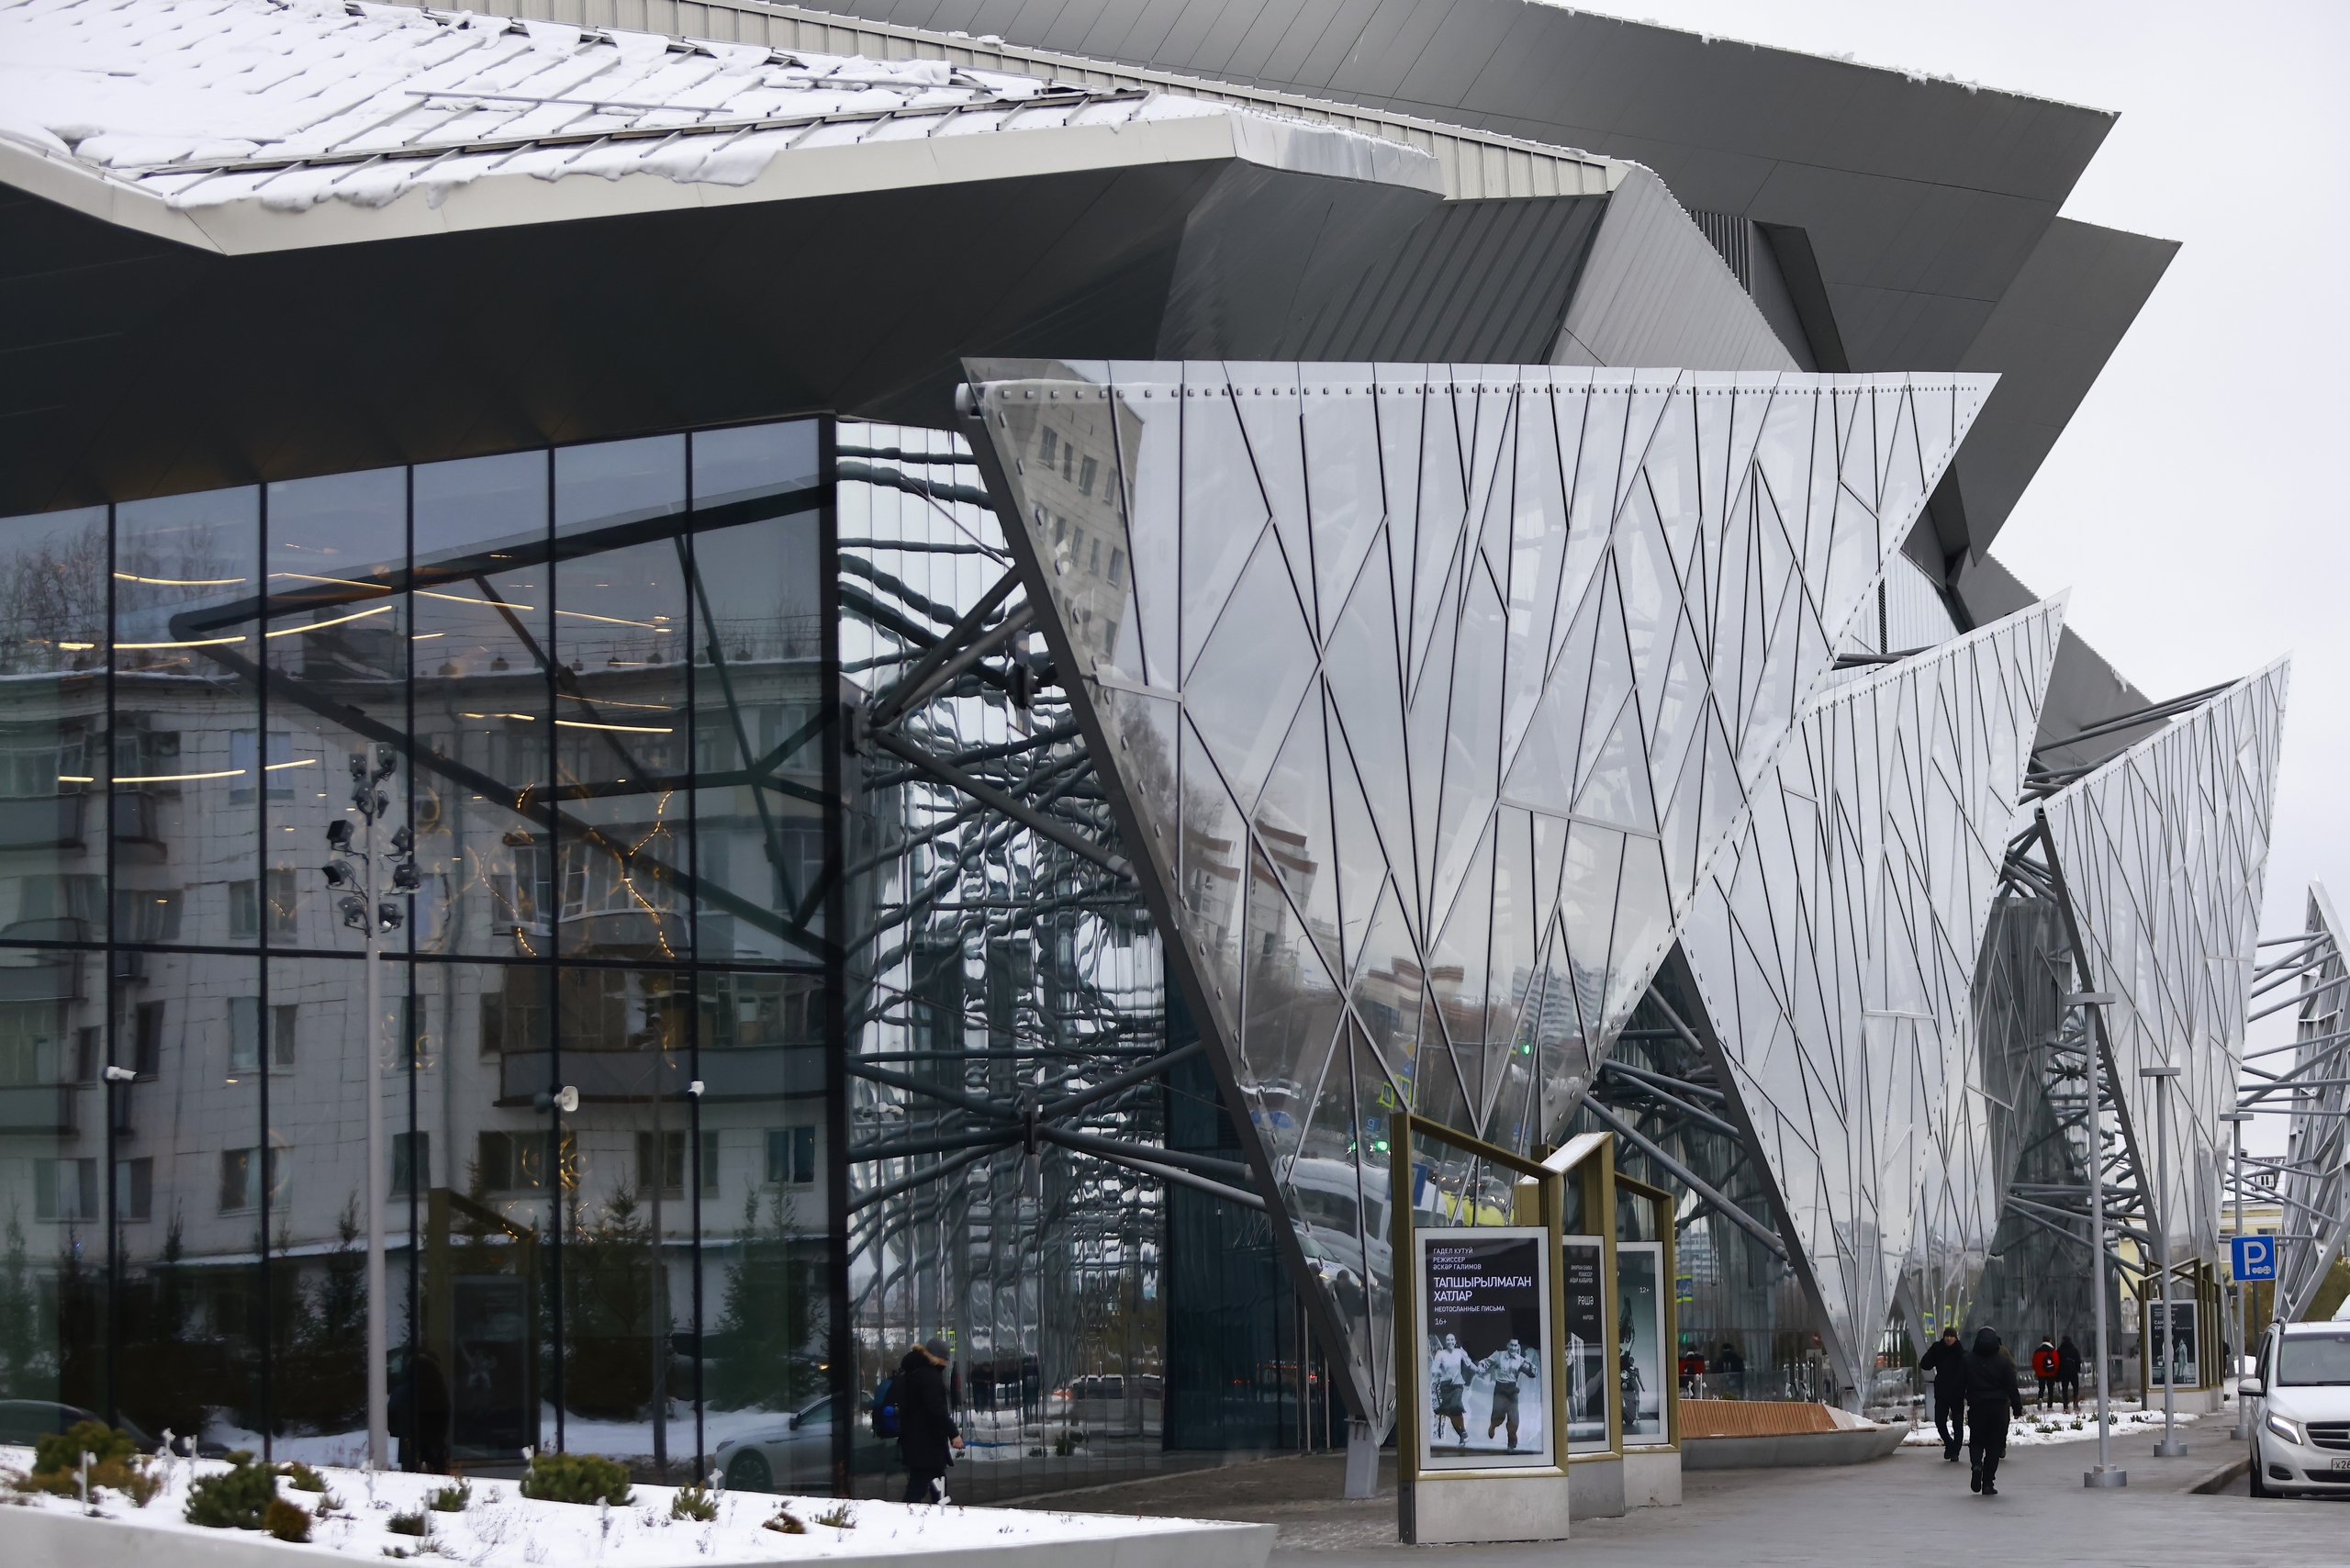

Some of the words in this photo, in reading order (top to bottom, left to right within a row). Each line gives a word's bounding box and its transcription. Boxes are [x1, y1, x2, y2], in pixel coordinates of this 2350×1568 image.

[2243, 1241, 2266, 1276] P
[1434, 1276, 1532, 1288] ТАПШЫРЫЛМАГАН
[1434, 1291, 1473, 1302] ХАТЛАР
